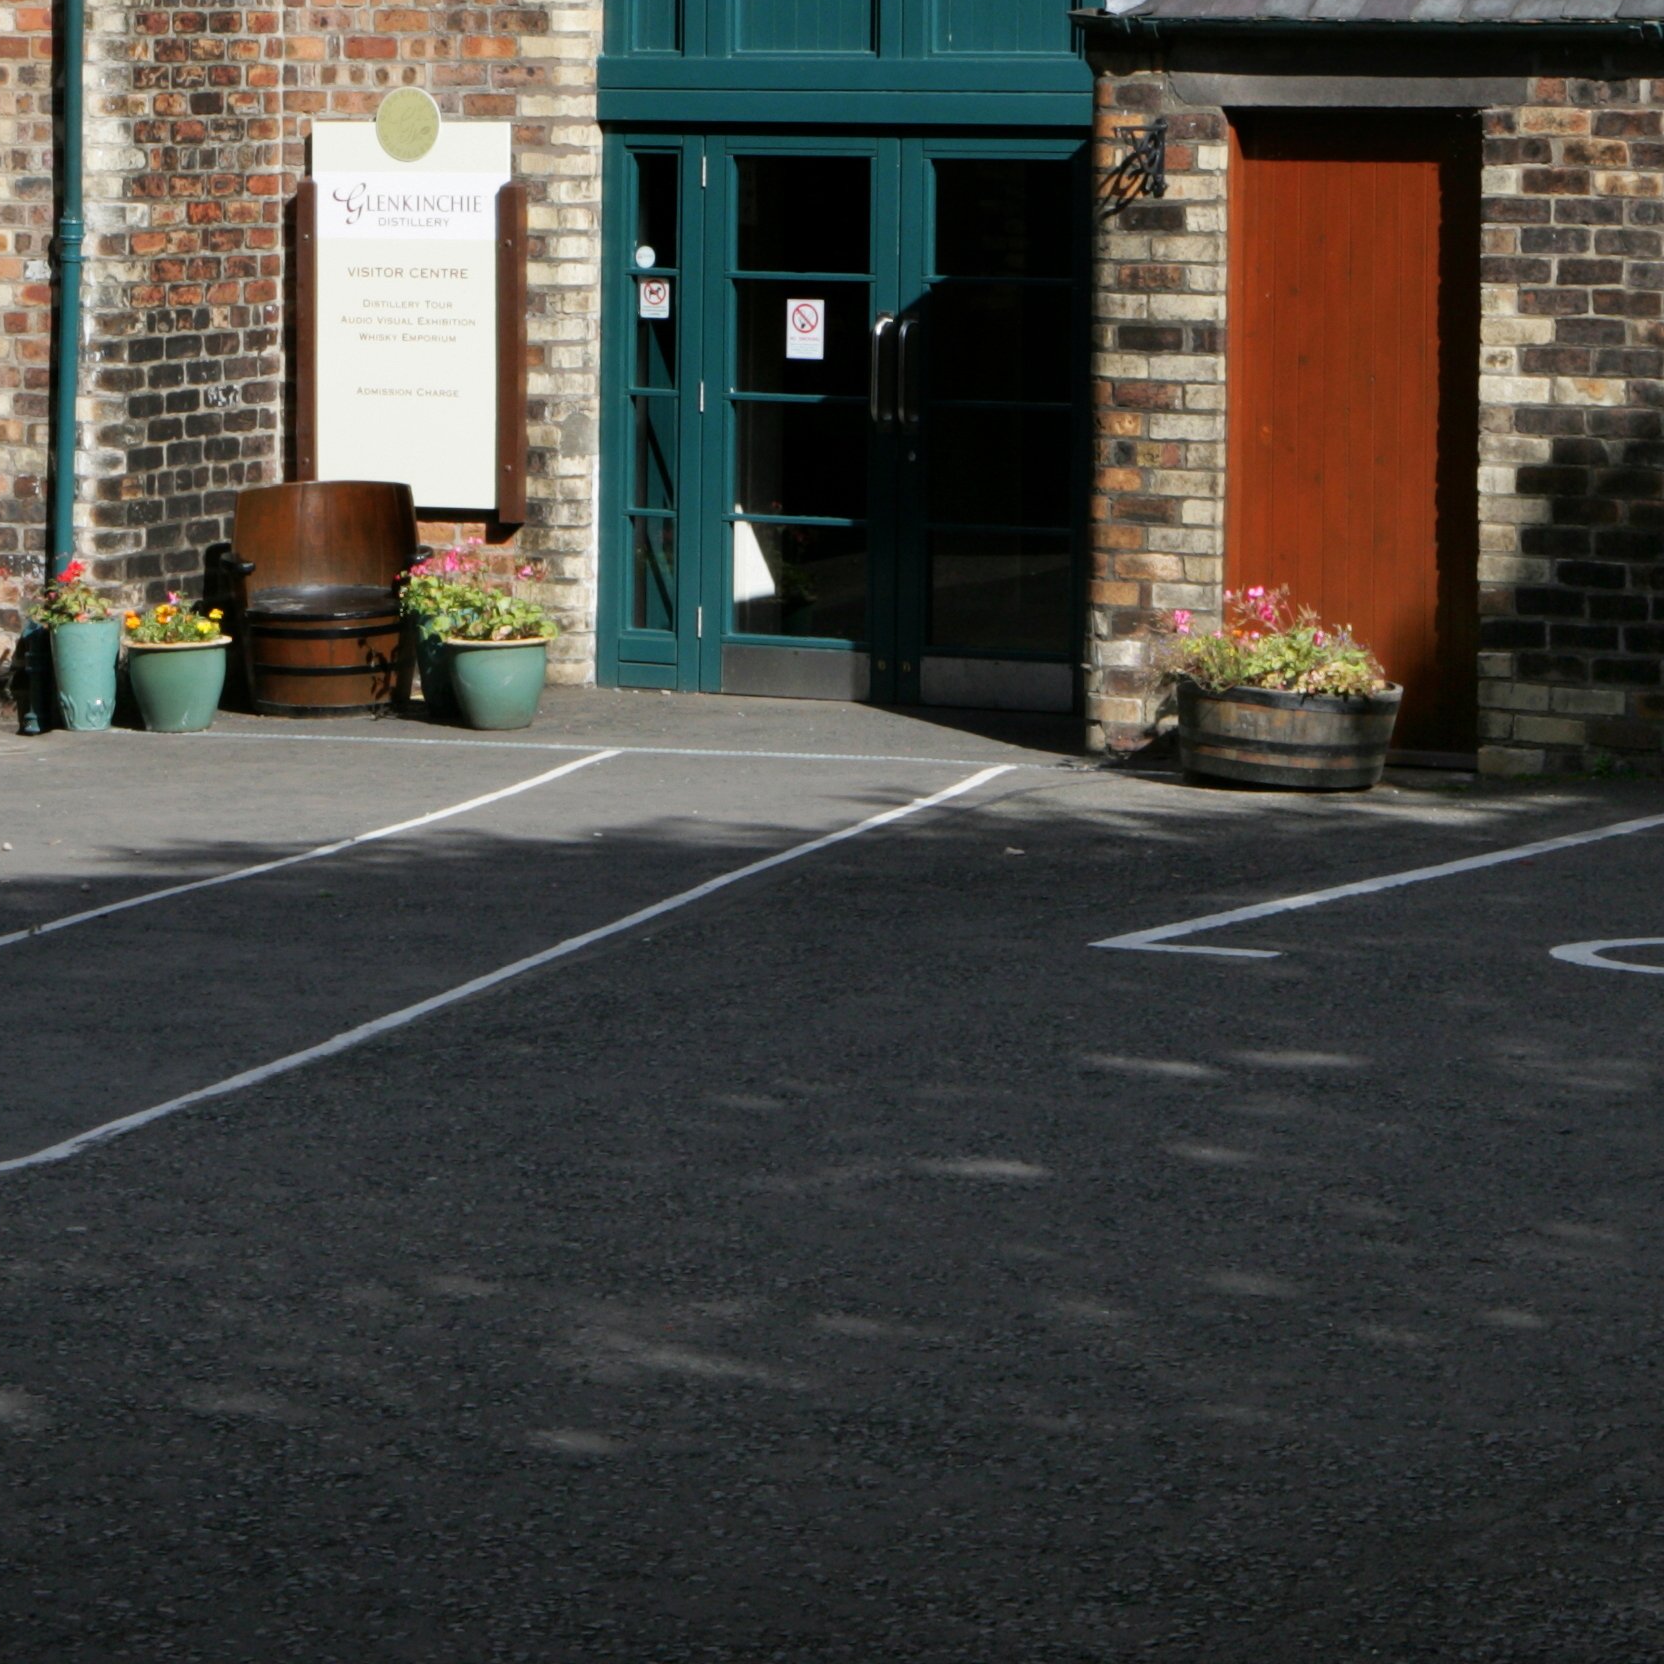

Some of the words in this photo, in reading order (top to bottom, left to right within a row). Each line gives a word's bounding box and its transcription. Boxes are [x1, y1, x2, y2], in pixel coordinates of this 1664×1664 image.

[332, 182, 482, 225] GLENKINCHIE
[378, 217, 450, 227] DISTILLERY
[347, 267, 404, 278] VISITOR
[409, 268, 469, 279] CENTRE
